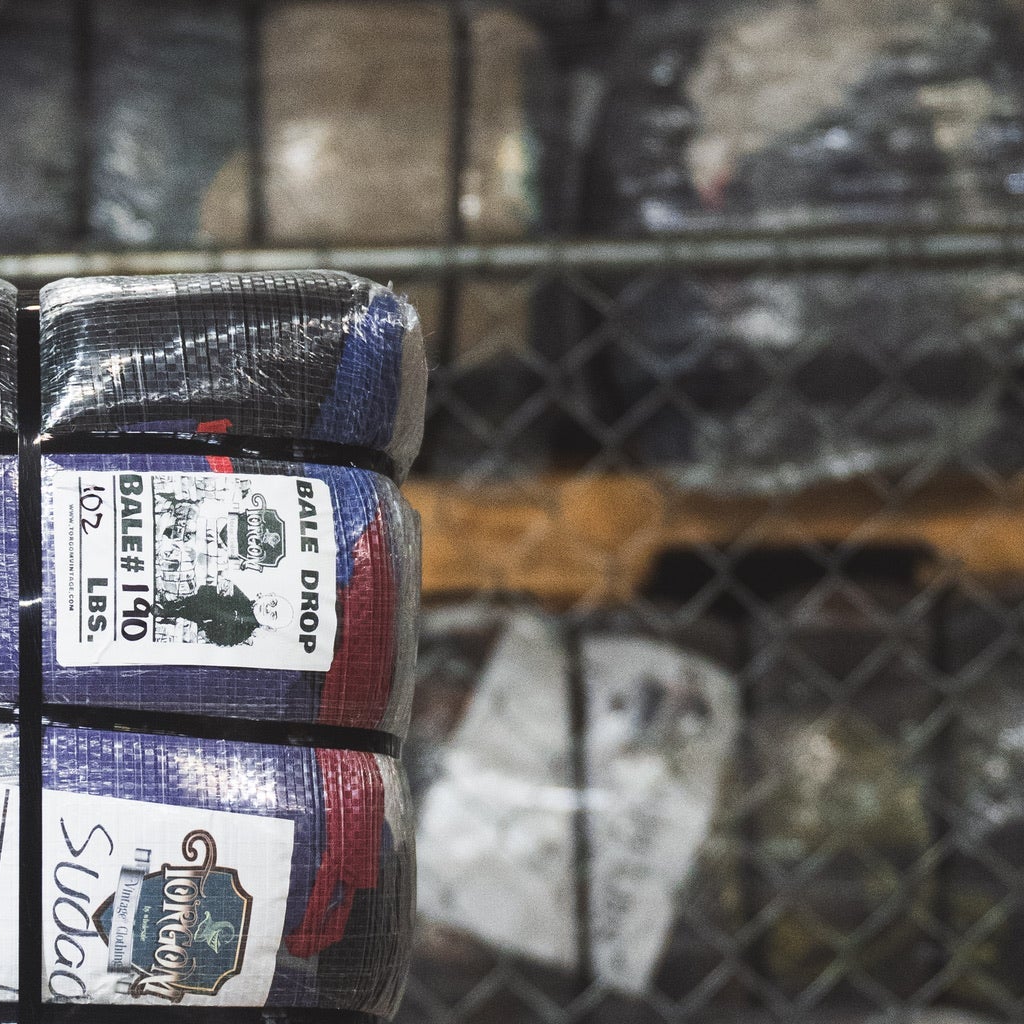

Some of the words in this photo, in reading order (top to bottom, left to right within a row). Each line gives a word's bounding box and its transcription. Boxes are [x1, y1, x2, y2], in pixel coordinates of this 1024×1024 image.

[80, 486, 106, 535] 102
[119, 474, 145, 573] BALE#
[238, 493, 267, 573] TORGOM
[295, 479, 320, 554] BALE
[86, 577, 109, 642] LBS.
[121, 584, 152, 642] 190
[297, 569, 320, 655] DROP
[111, 926, 131, 968] Clothing
[131, 829, 217, 1002] TORGOM
